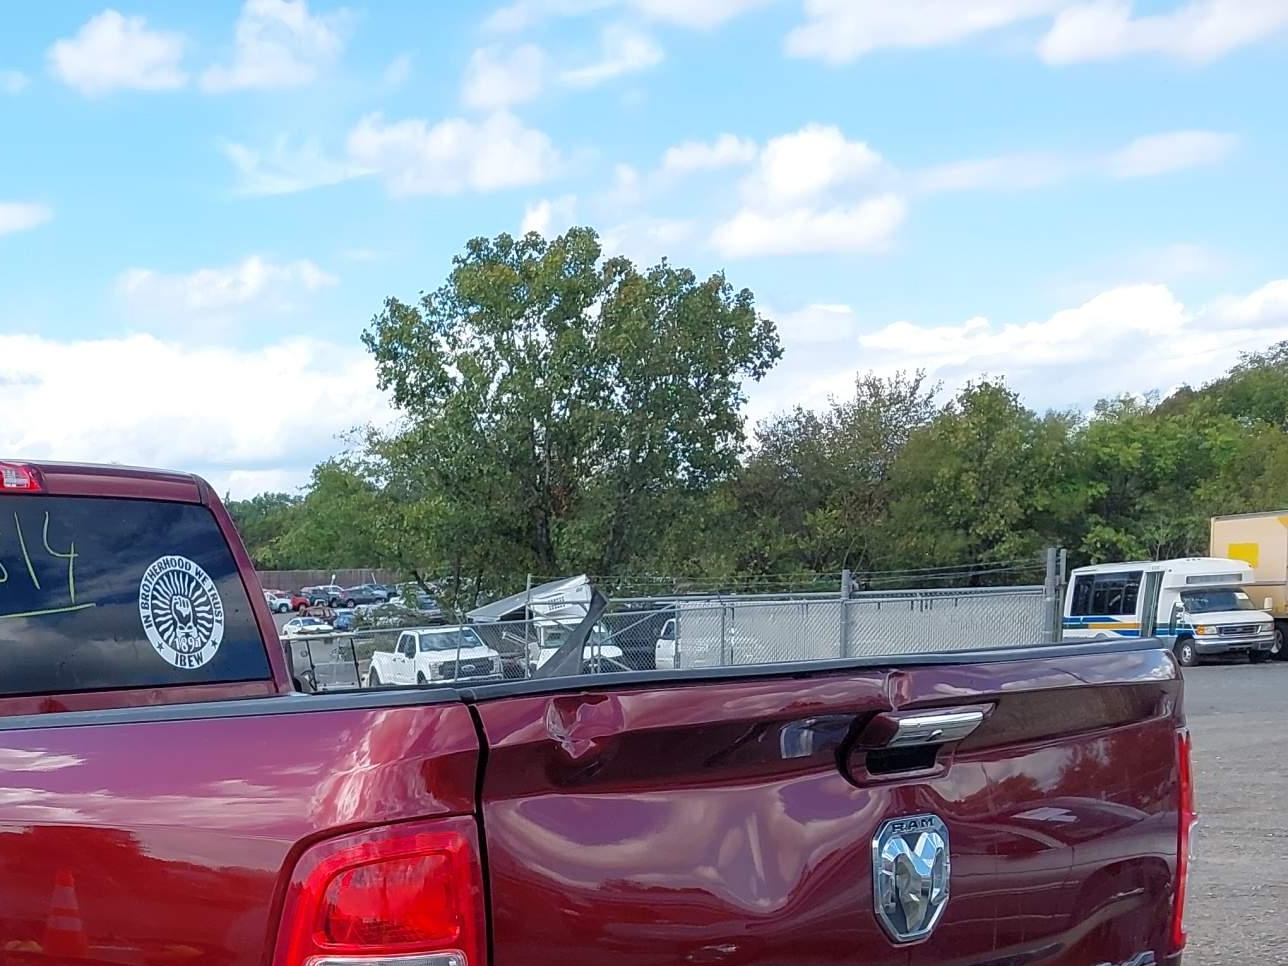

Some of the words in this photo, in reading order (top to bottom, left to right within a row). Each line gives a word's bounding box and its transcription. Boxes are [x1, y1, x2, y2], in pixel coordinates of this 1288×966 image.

[141, 558, 192, 610] BROTHERHOOD
[195, 567, 209, 585] WE
[208, 586, 223, 625] TRUST
[142, 615, 153, 629] IN
[174, 652, 204, 667] IBEW
[892, 818, 934, 833] RAM
